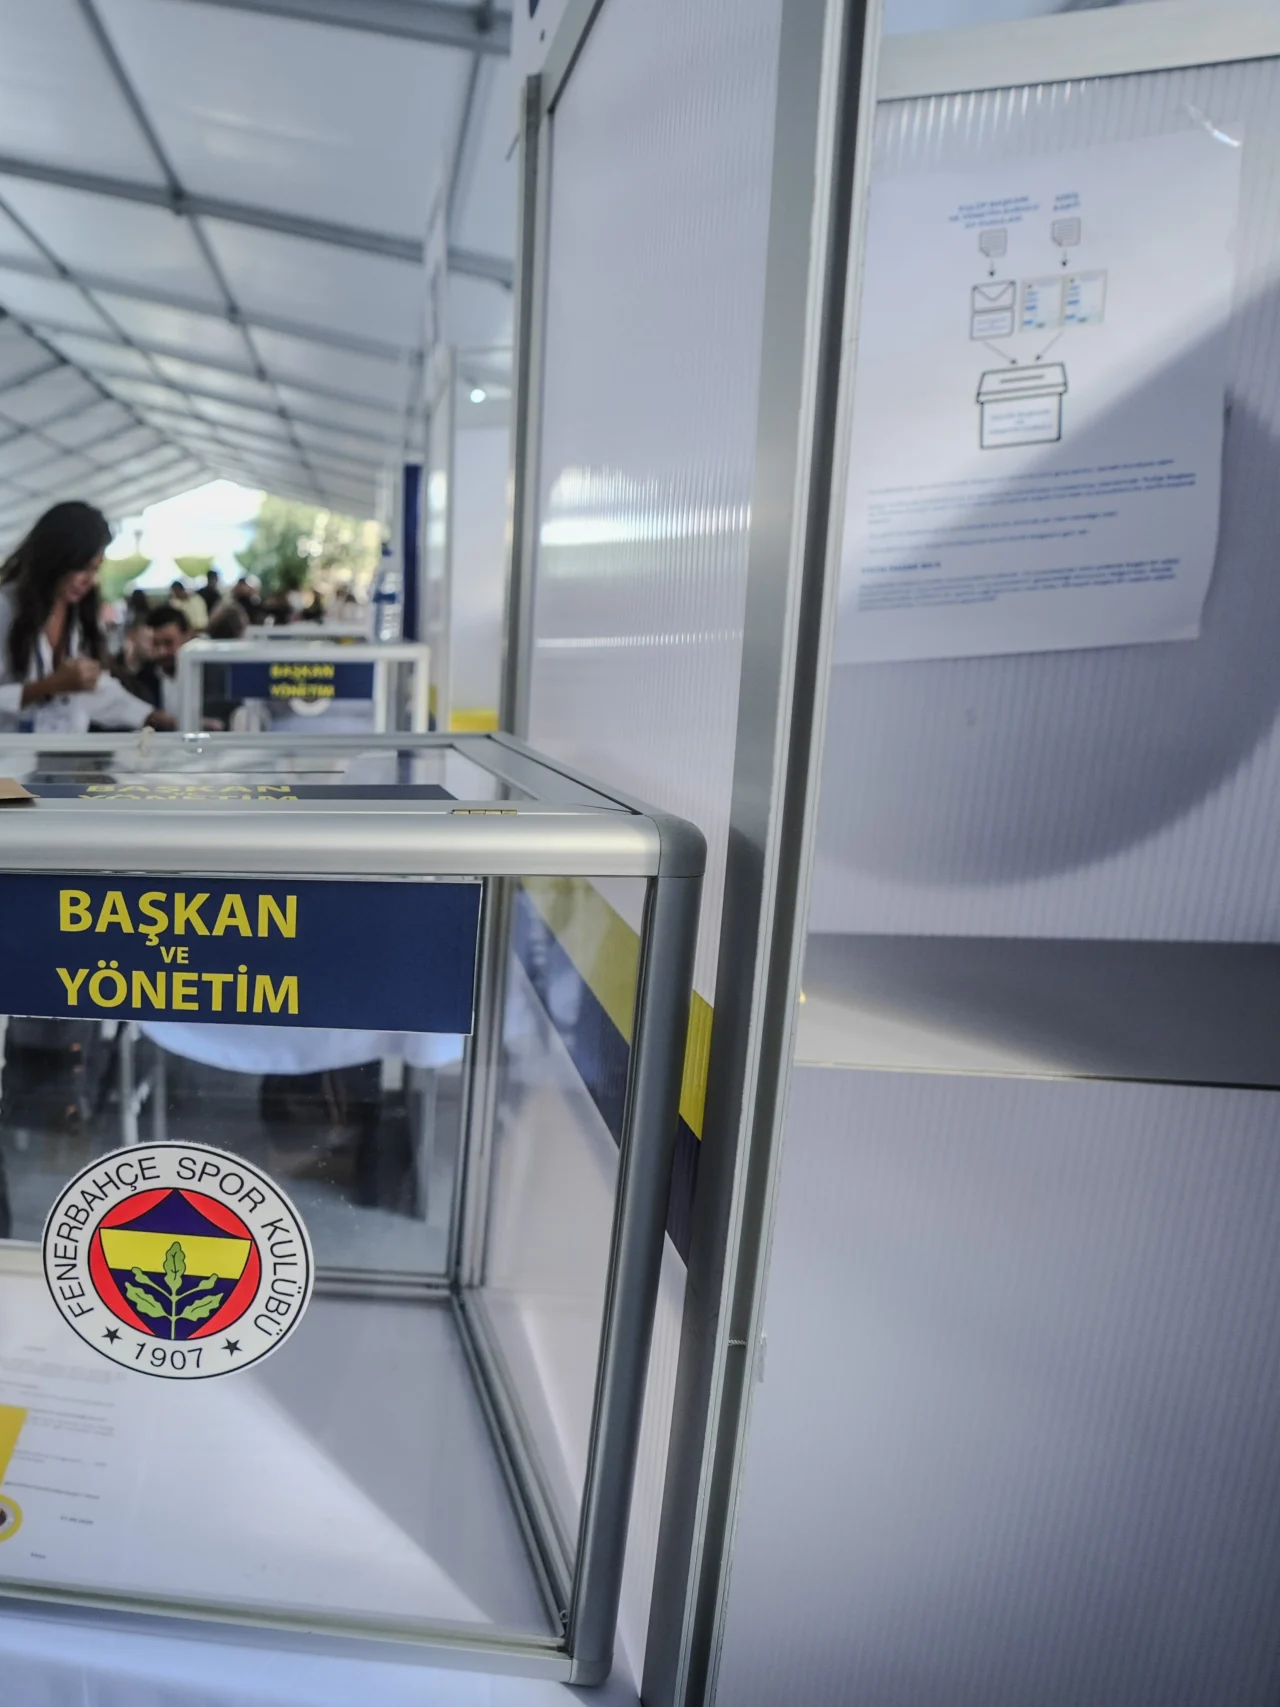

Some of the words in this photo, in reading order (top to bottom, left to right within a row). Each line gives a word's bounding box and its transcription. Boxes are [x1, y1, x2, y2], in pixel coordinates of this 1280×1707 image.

[86, 785, 291, 794] BAŞKAN
[58, 889, 298, 946] BAŞKAN
[159, 946, 190, 964] VE
[55, 959, 299, 1015] YÖNETİM
[53, 1156, 161, 1318] FENERBAHÇE
[176, 1156, 267, 1214] SPOR
[253, 1217, 303, 1337] KULÜBÜ
[134, 1342, 204, 1370] 1907
